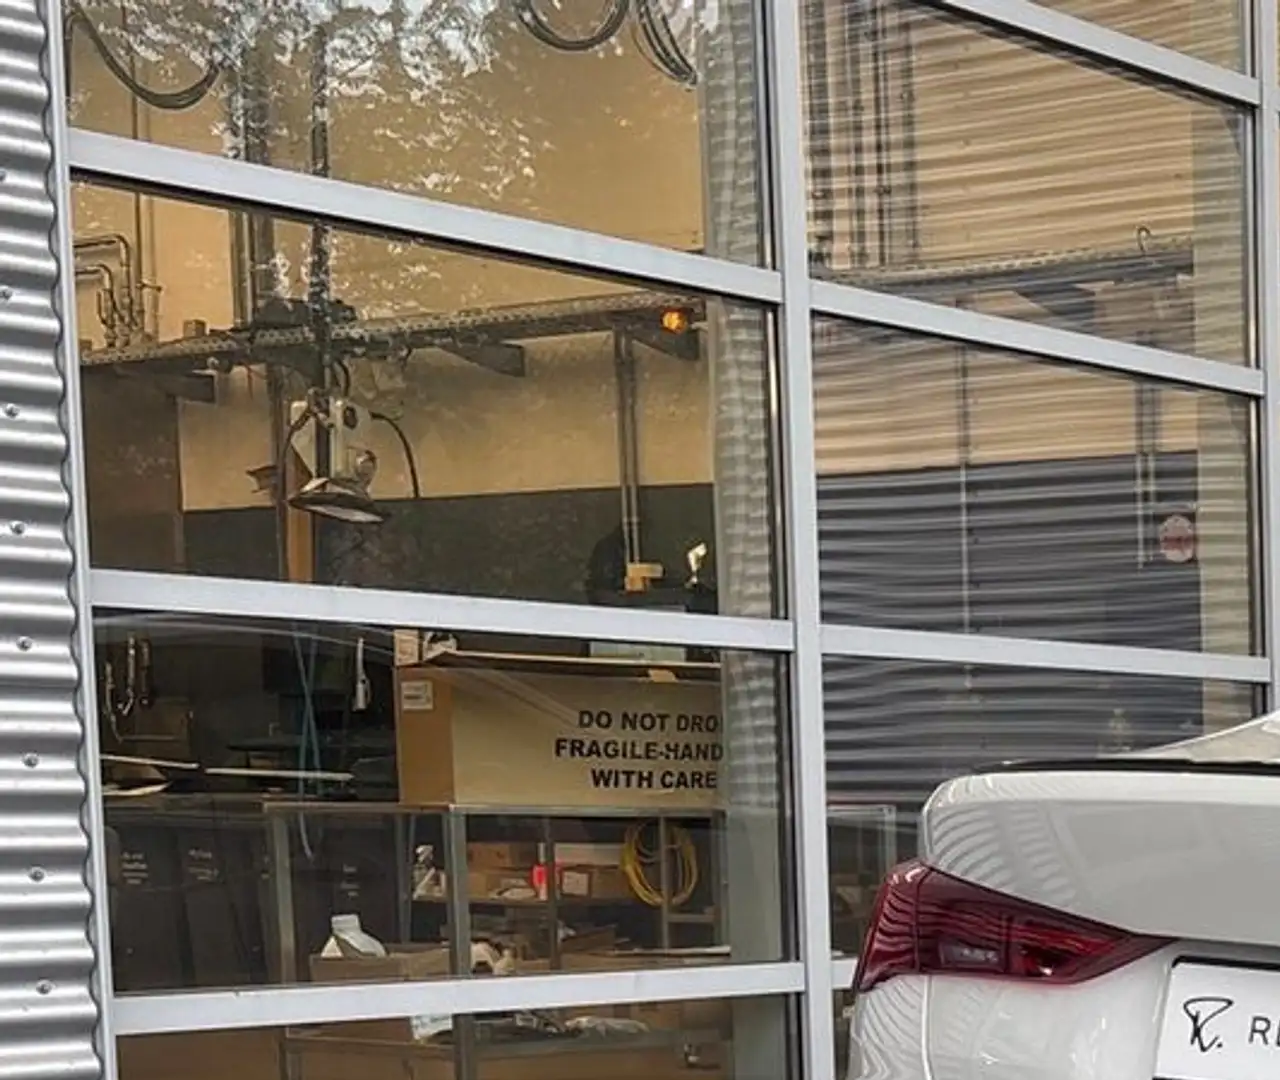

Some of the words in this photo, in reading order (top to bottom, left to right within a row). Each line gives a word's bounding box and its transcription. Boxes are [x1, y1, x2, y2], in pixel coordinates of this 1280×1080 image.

[578, 709, 613, 729] DO
[621, 711, 671, 731] NOT
[676, 714, 724, 733] DRO
[591, 768, 654, 789] WITH
[660, 770, 718, 789] CARE
